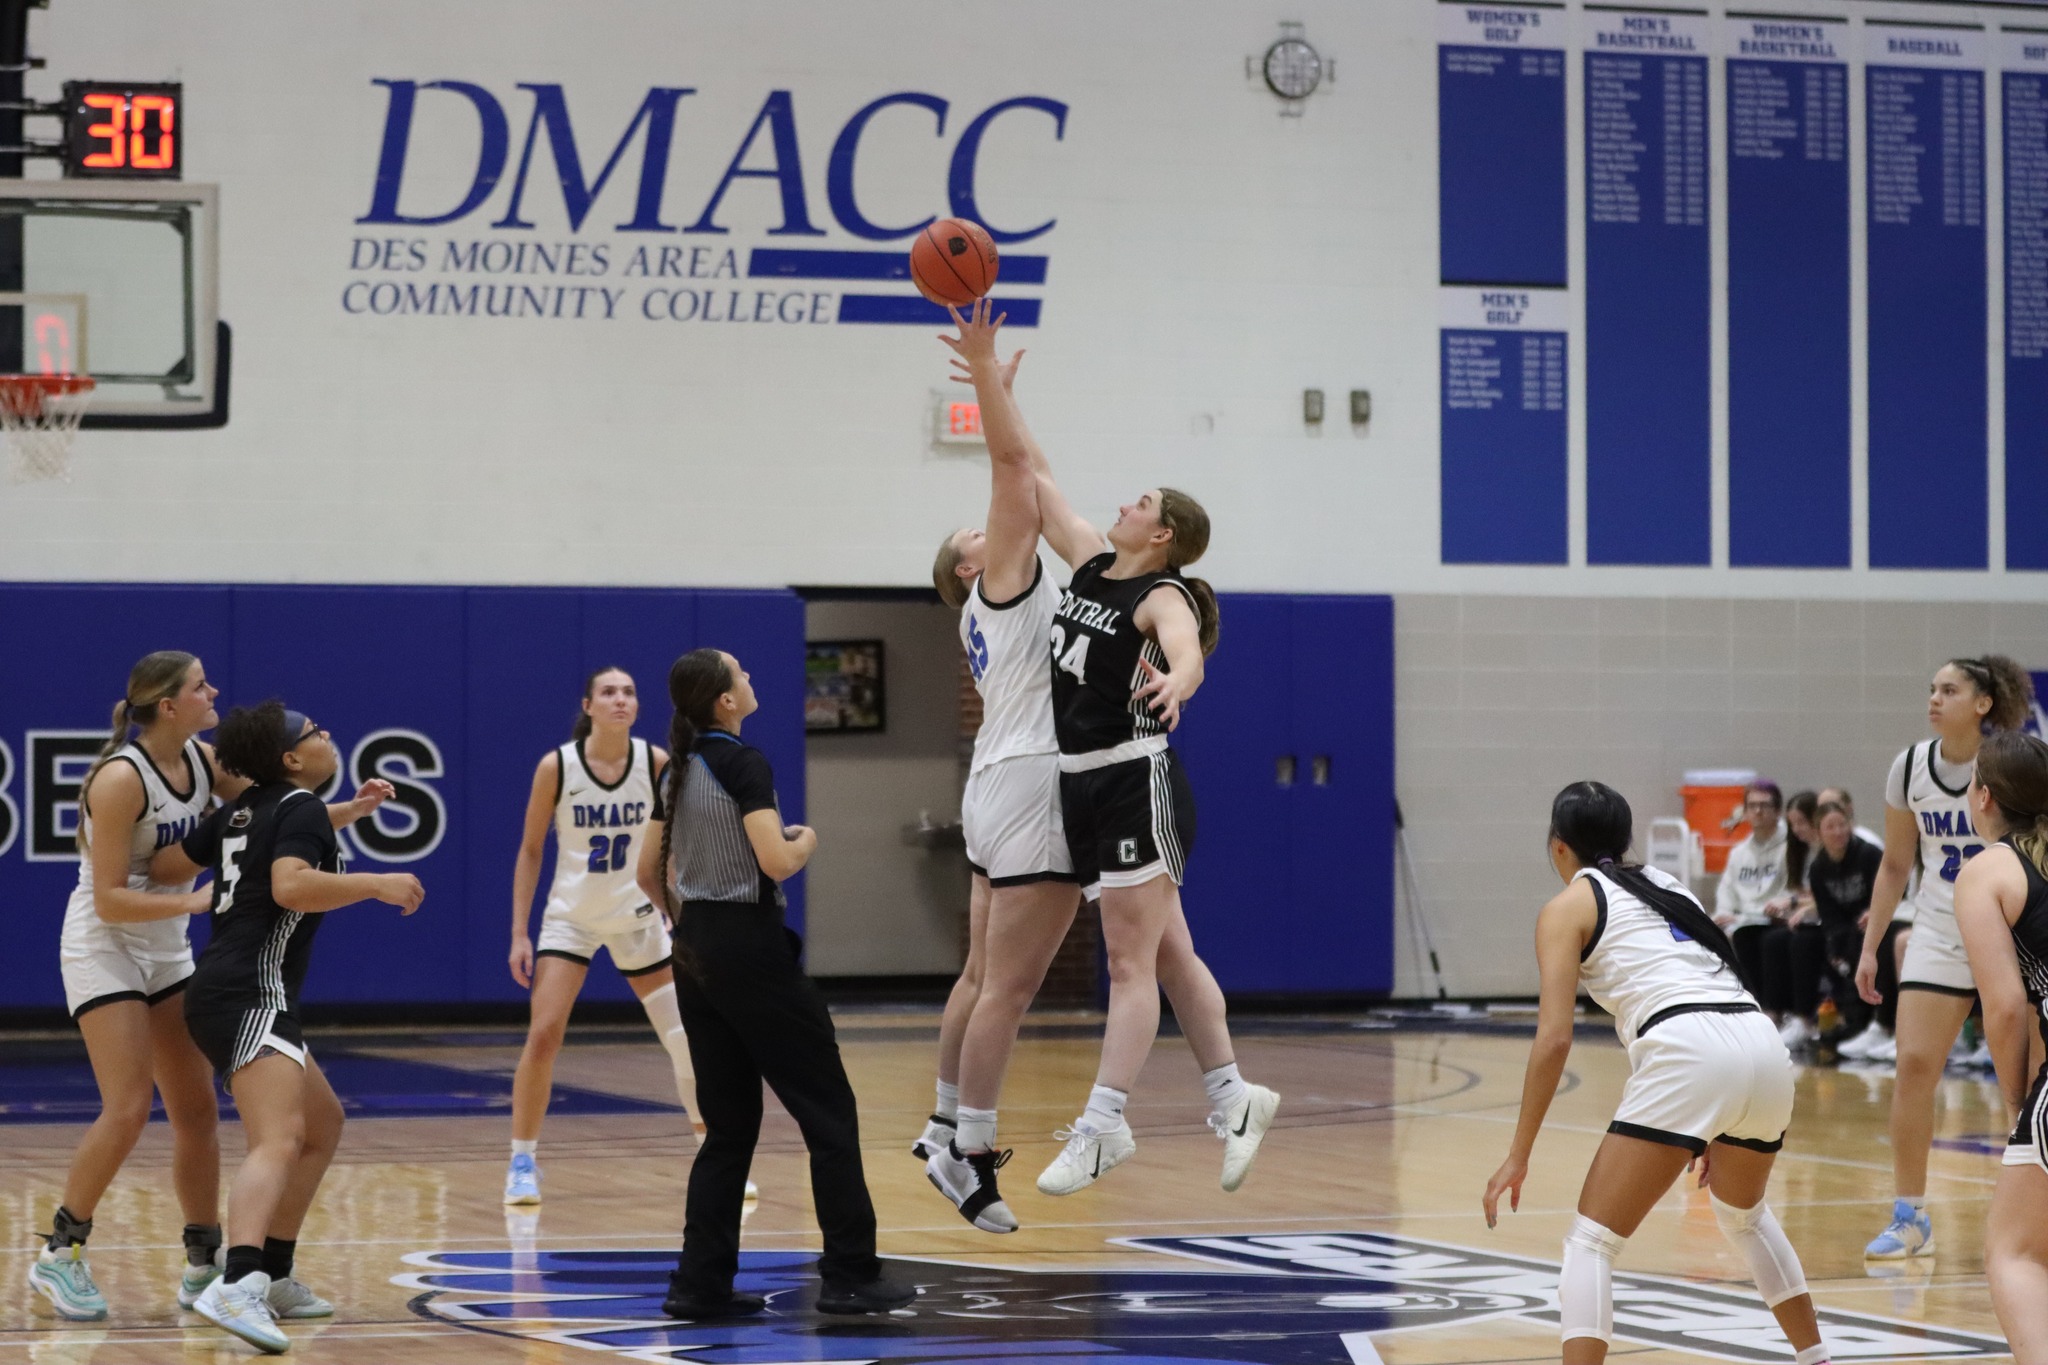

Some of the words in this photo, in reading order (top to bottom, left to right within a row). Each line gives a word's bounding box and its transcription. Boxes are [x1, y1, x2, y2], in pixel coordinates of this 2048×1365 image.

[1596, 32, 1696, 50] BASKETBALL
[1739, 40, 1837, 57] BASKETBALL
[1887, 37, 1963, 57] BASEBALL
[82, 93, 174, 168] 30
[353, 77, 1069, 244] DMACC
[349, 238, 427, 271] DES
[441, 240, 610, 277] MOINES
[622, 245, 740, 279] AREA
[342, 281, 625, 319] COMMUNITY
[641, 288, 831, 324] COLLEGE
[1486, 310, 1523, 324] GOLF
[1056, 588, 1121, 636] ENTRAL
[573, 802, 645, 828] DMACC
[1920, 810, 1979, 837] DMA
[588, 834, 632, 873] 20
[215, 835, 248, 914] 5
